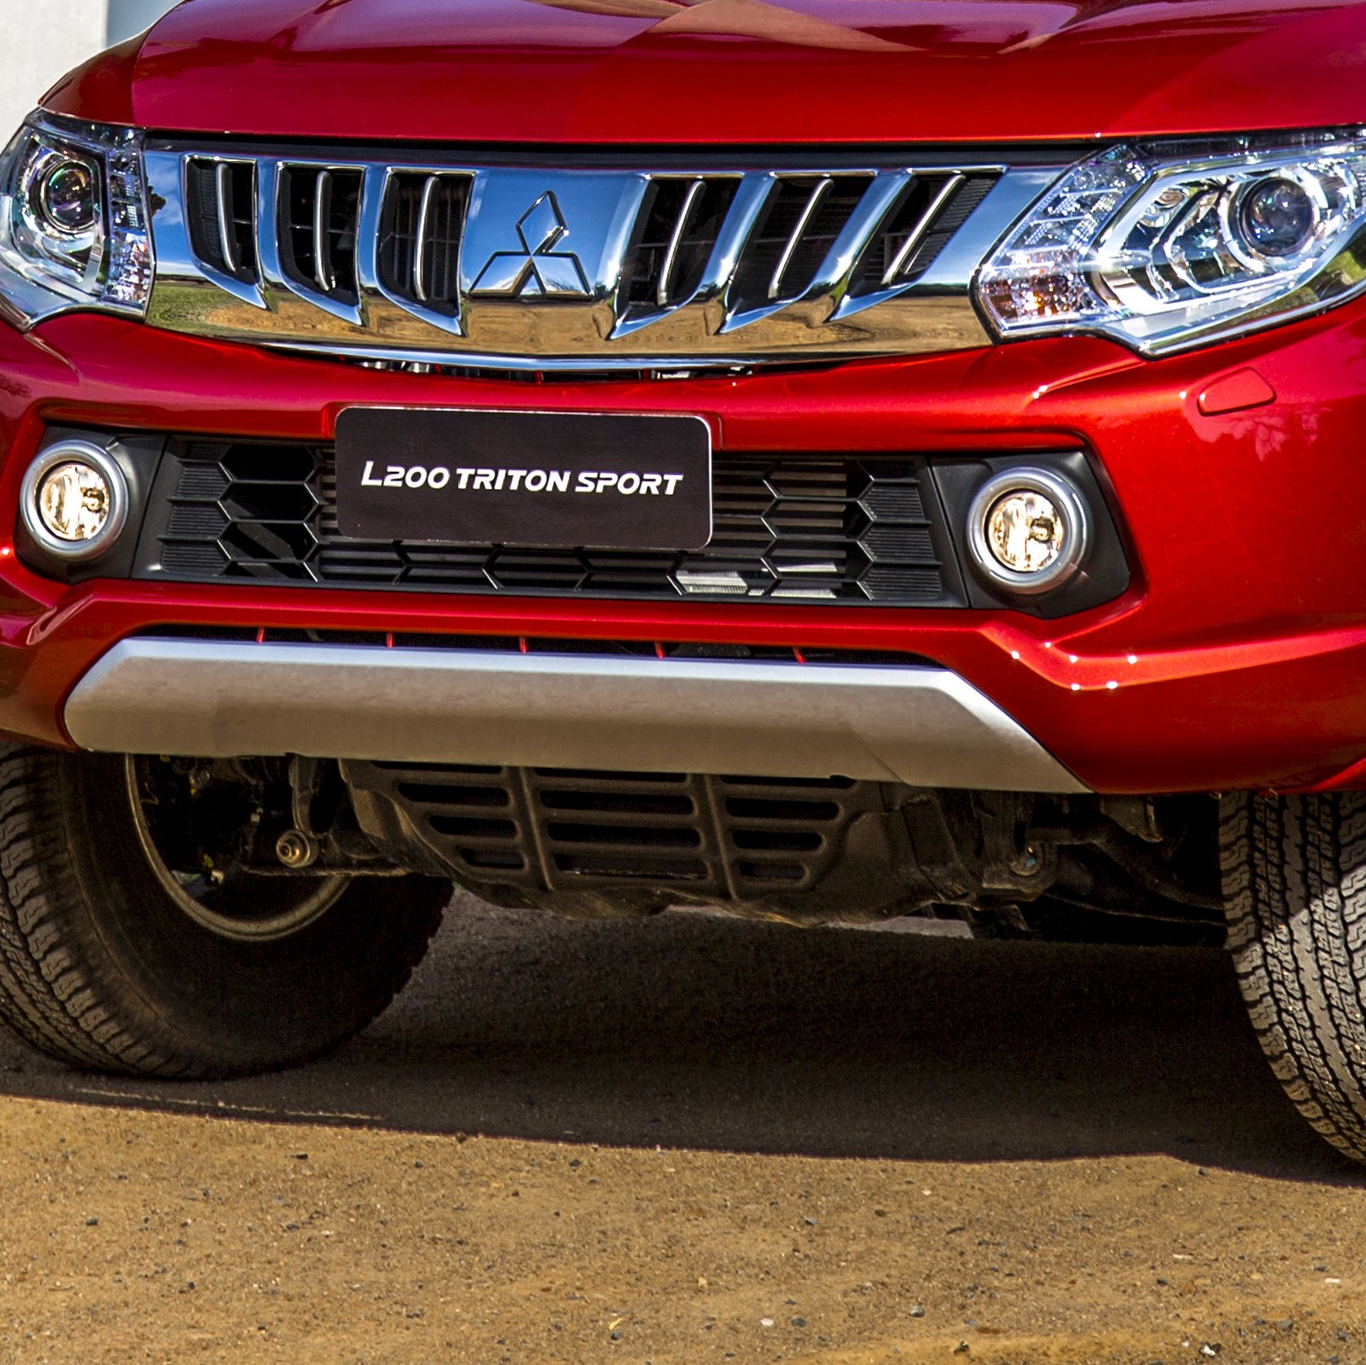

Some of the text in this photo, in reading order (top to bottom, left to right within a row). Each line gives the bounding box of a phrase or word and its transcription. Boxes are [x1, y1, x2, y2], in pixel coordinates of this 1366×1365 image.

[360, 460, 684, 496] L200 TRITON SPORT
